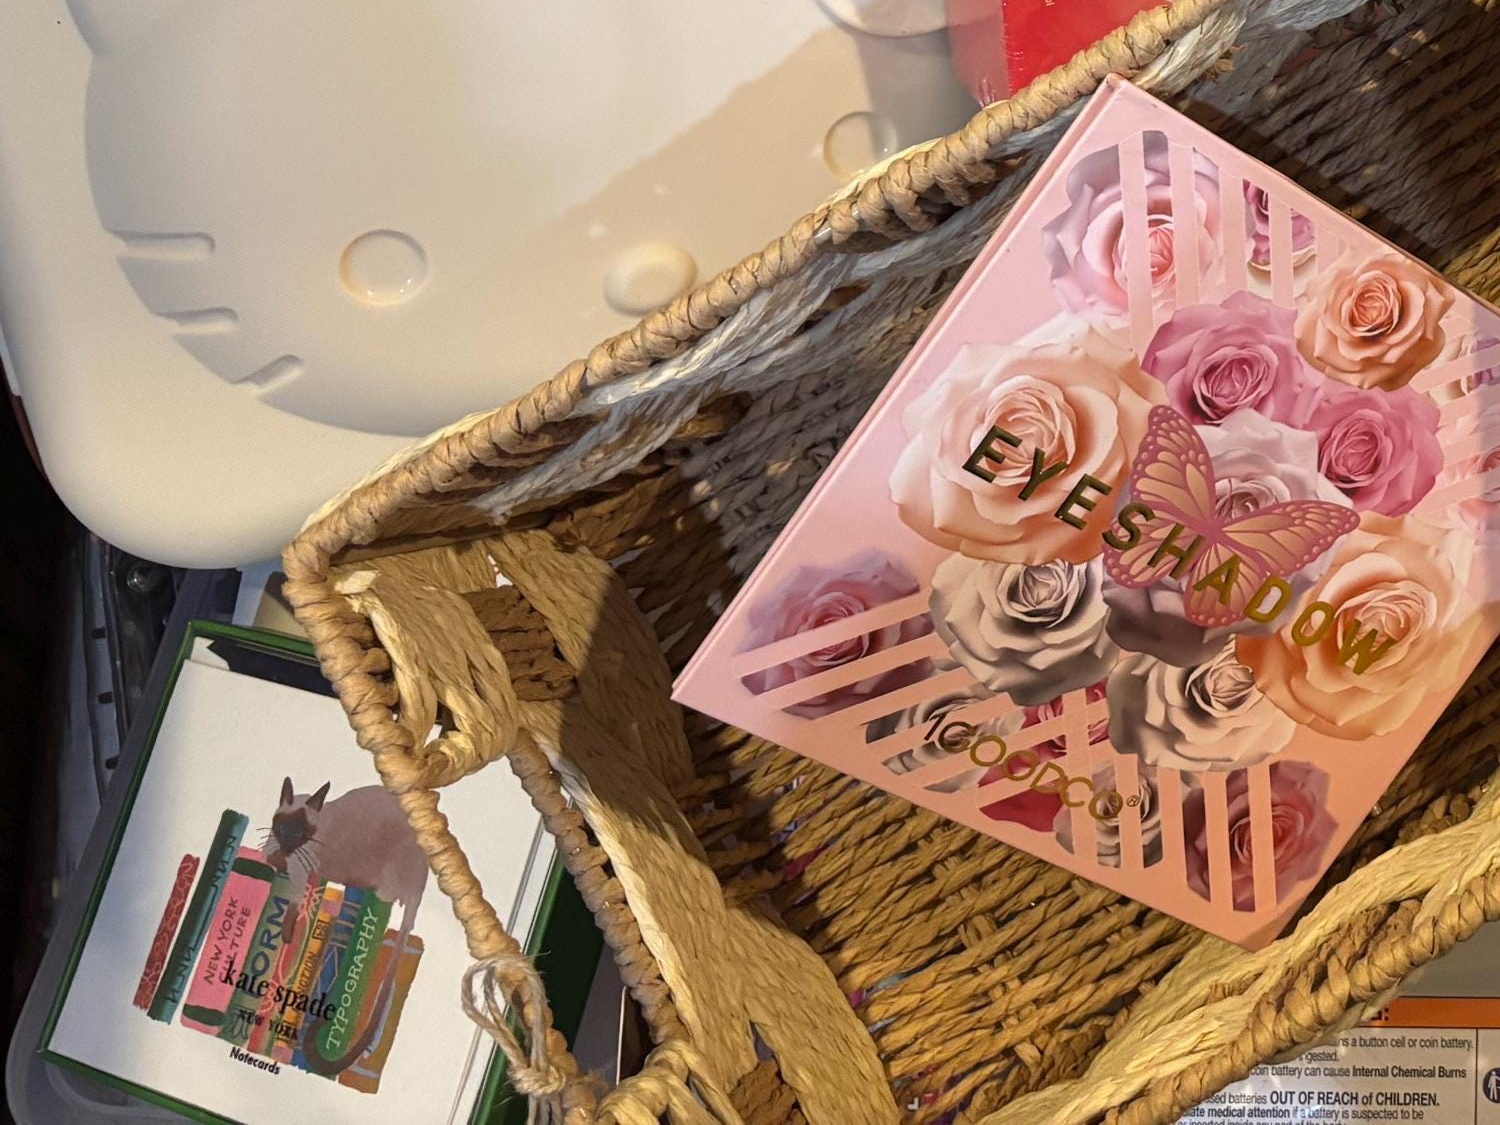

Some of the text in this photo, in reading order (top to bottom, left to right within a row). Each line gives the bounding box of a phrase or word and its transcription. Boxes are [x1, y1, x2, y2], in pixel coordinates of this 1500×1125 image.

[962, 425, 1396, 675] EYESHADOW
[922, 713, 1126, 821] IGOODCO
[204, 896, 239, 986] NEW YORK
[221, 960, 337, 1022] kate spade
[326, 907, 379, 1051] TYPOGRAPHY
[238, 1007, 299, 1041] NEW YORK
[229, 1046, 280, 1075] Notecards
[1351, 1036, 1473, 1051] a button cell or coin battery.
[1271, 1065, 1303, 1079] battery
[1304, 1066, 1321, 1076] can
[1323, 1067, 1350, 1076] cause
[1352, 1065, 1389, 1078] Internal
[1390, 1065, 1436, 1078] Chemical
[1438, 1067, 1466, 1078] Burns
[1207, 1107, 1246, 1118] medical
[1247, 1106, 1290, 1118] attention
[1308, 1107, 1340, 1121] battery
[1341, 1108, 1350, 1118] is
[1351, 1108, 1398, 1121] suspected
[1400, 1109, 1410, 1119] to
[1412, 1108, 1424, 1120] be
[1228, 1090, 1440, 1107] batteries OUT OF REACH of CHILDREN.
